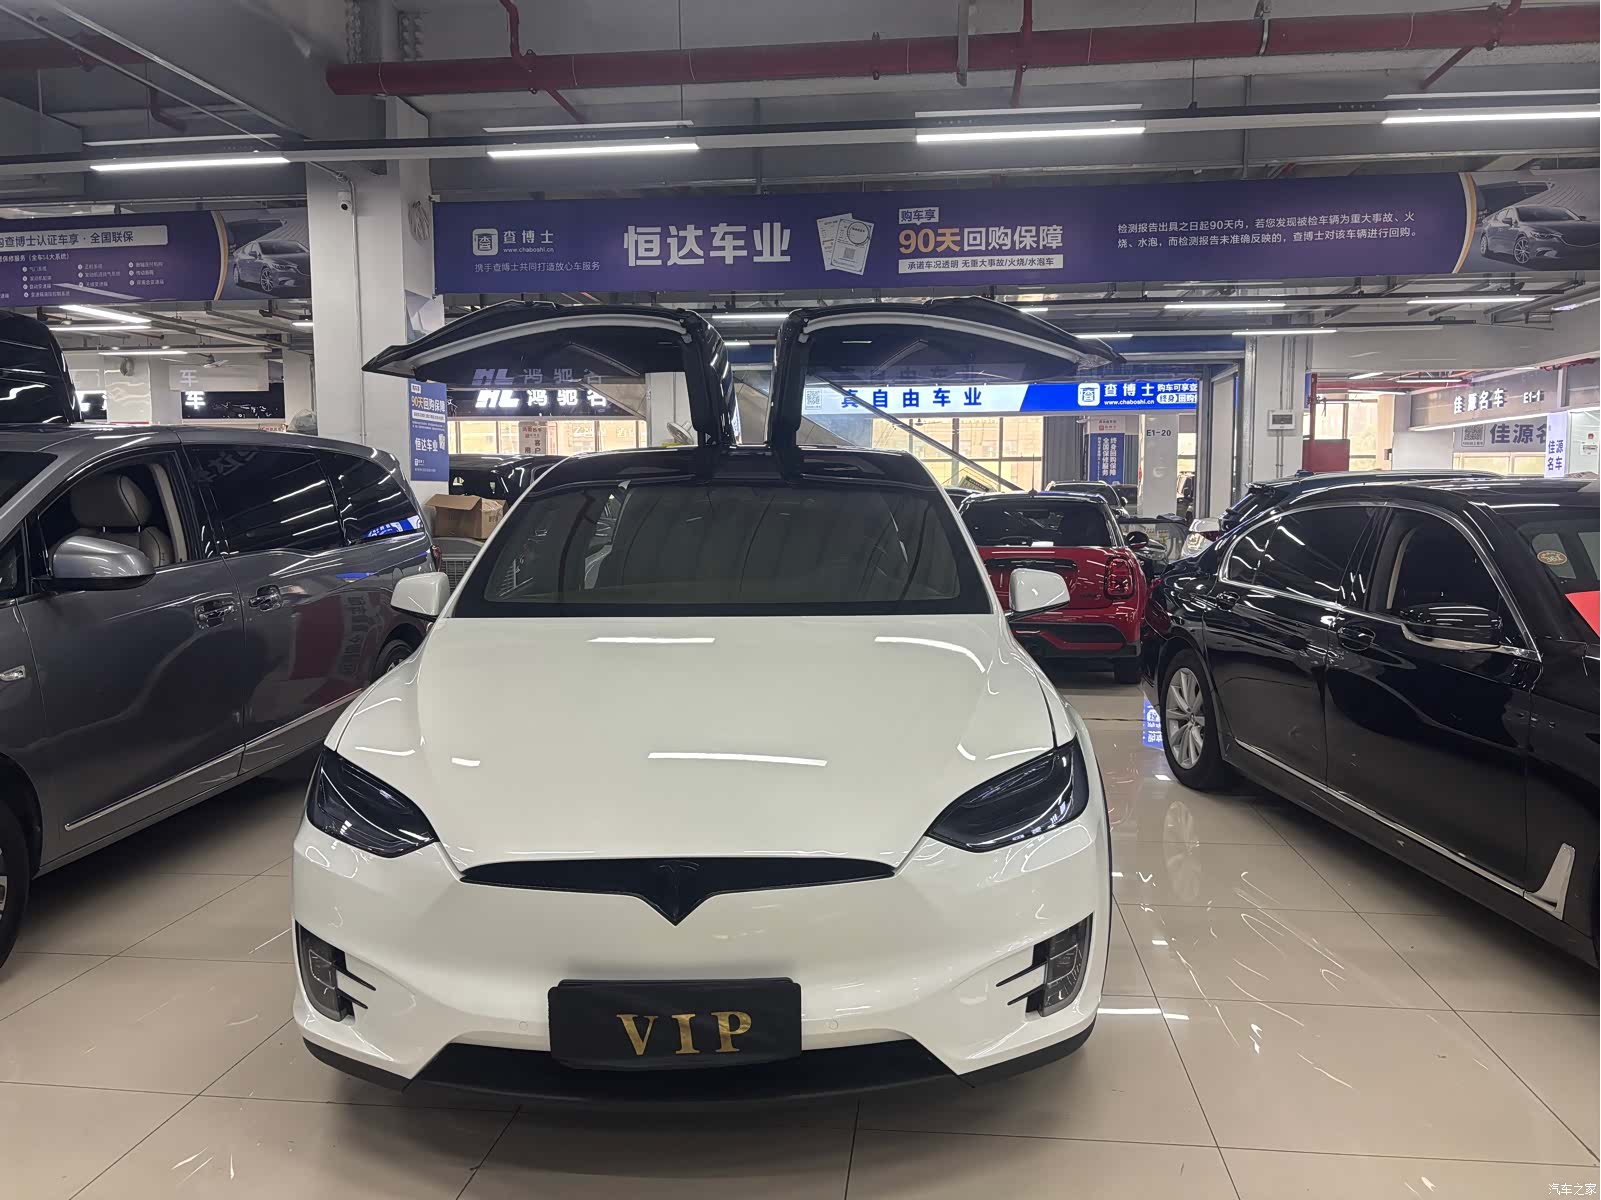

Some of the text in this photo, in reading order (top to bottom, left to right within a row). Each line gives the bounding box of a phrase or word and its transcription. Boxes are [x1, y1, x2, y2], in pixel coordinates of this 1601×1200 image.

[900, 209, 936, 222] 购车享
[503, 229, 554, 244] 查博士
[899, 224, 1064, 254] 90天回购保障
[623, 222, 791, 267] 恒达车业
[180, 369, 199, 387] 车
[1104, 383, 1155, 397] 查博士
[1523, 390, 1543, 404] E1-1
[185, 390, 206, 410] 车
[1146, 429, 1172, 437] E1-20
[415, 437, 438, 452] 恒达车业
[616, 1011, 752, 1056] VIP
